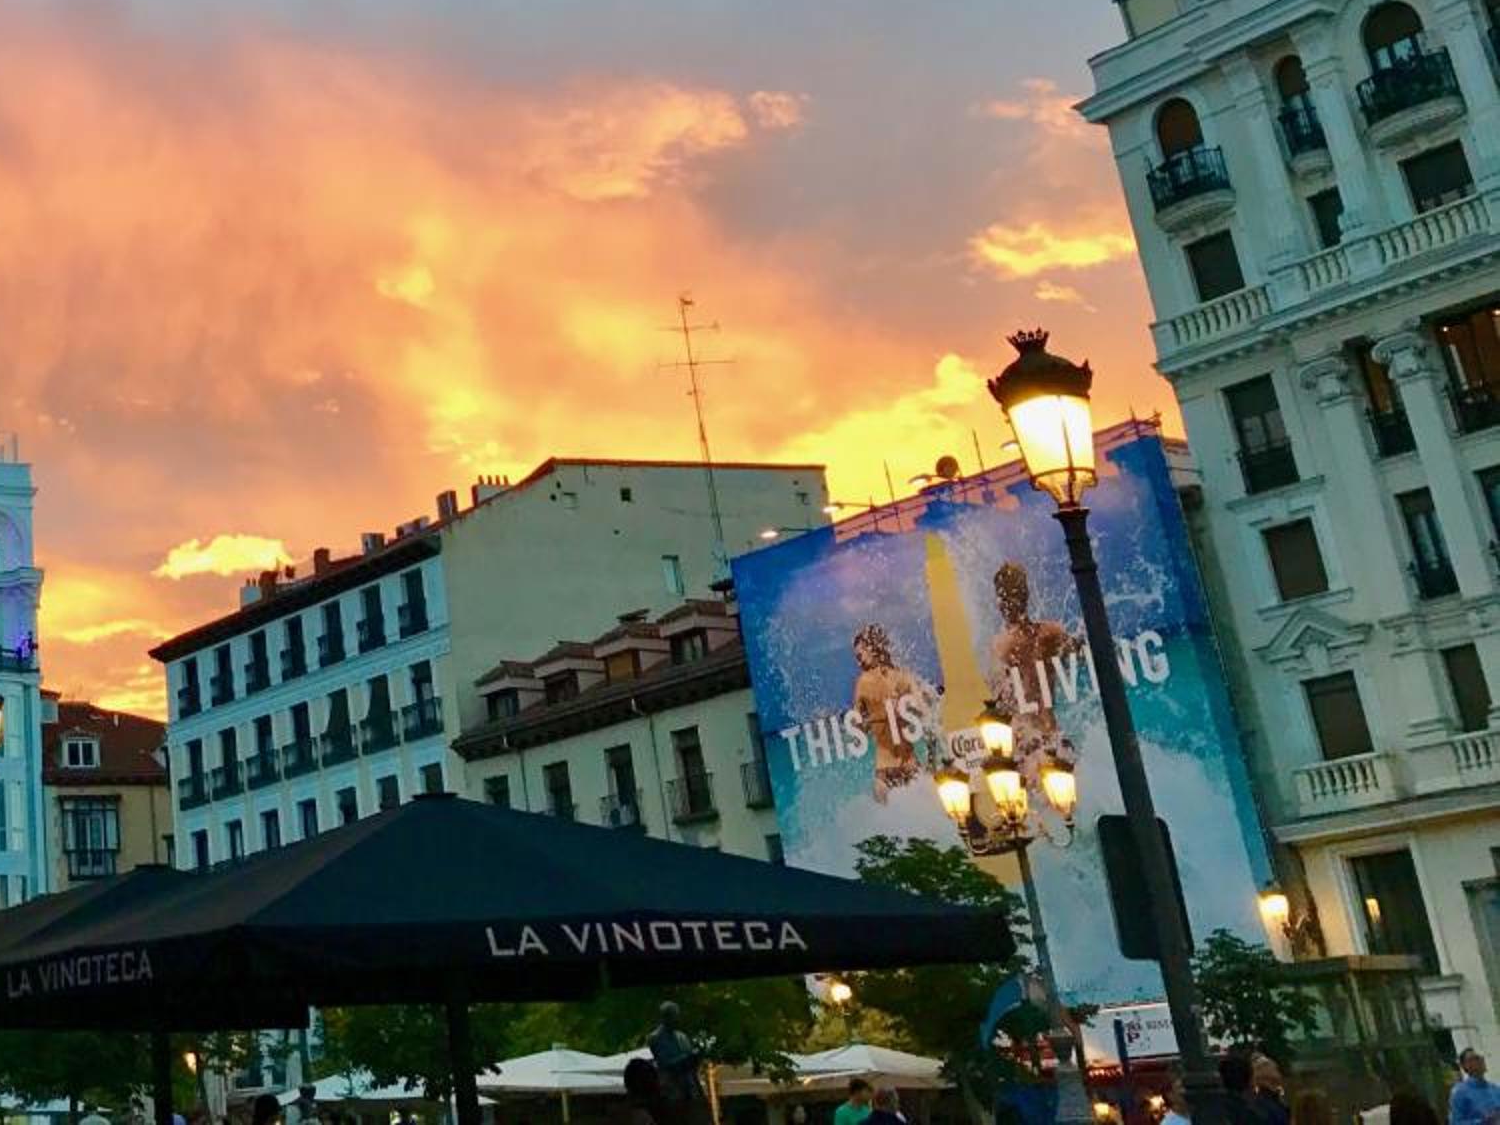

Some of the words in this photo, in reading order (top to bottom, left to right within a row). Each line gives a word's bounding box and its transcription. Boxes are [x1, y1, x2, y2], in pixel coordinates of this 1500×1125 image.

[780, 709, 869, 771] THIS
[885, 693, 924, 746] IS
[1010, 630, 1171, 715] LIVING
[485, 925, 549, 956] LA
[560, 921, 808, 953] VINOTECA
[6, 971, 33, 998] LA
[38, 949, 154, 992] VINOTECA
